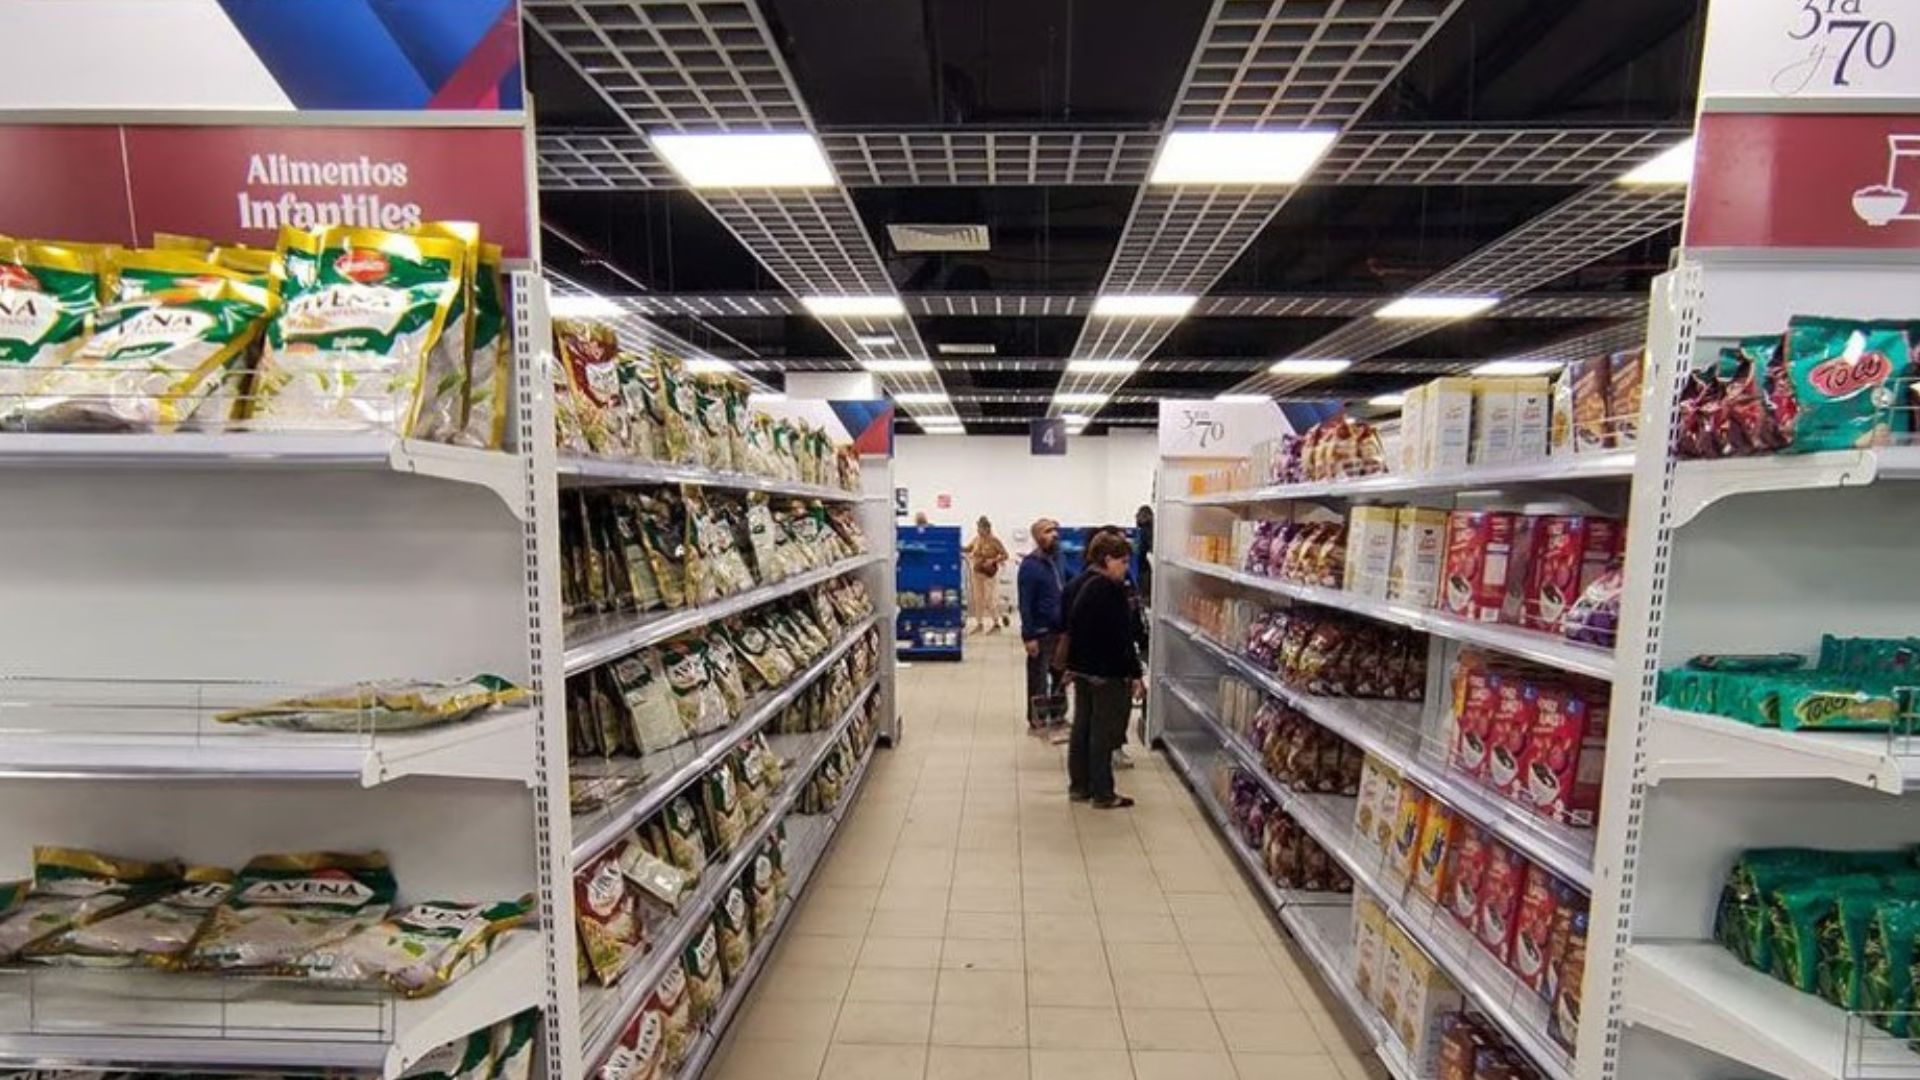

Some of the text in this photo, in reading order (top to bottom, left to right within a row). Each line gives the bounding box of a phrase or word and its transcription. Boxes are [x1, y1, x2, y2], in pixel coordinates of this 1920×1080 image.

[1827, 20, 1896, 86] 70
[247, 153, 408, 187] Alimentos
[237, 191, 422, 230] Infantiles
[1042, 428, 1055, 447] 4
[260, 883, 360, 896] AVENA
